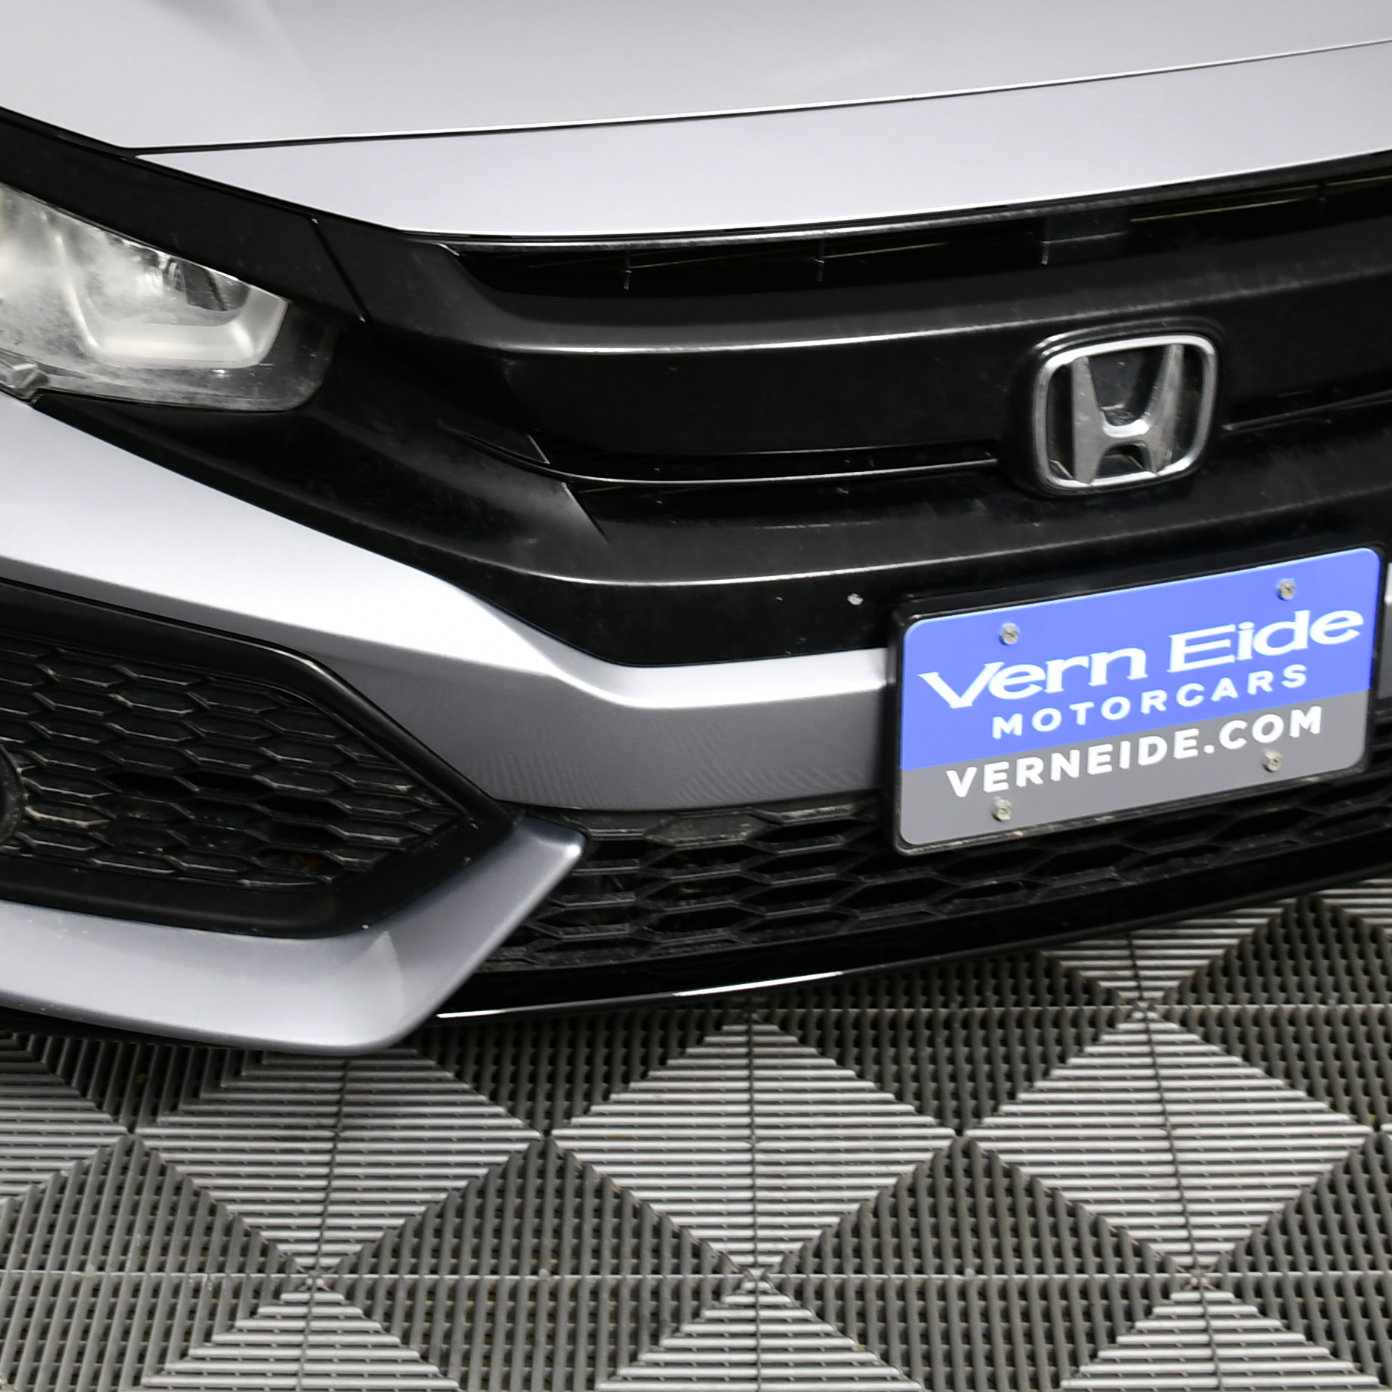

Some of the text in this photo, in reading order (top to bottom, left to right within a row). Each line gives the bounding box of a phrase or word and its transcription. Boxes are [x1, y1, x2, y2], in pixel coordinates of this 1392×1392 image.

[917, 609, 1366, 710] Vern Eide
[990, 664, 1308, 741] MOTORCARS
[945, 705, 1325, 800] VERNEIDE.COM
